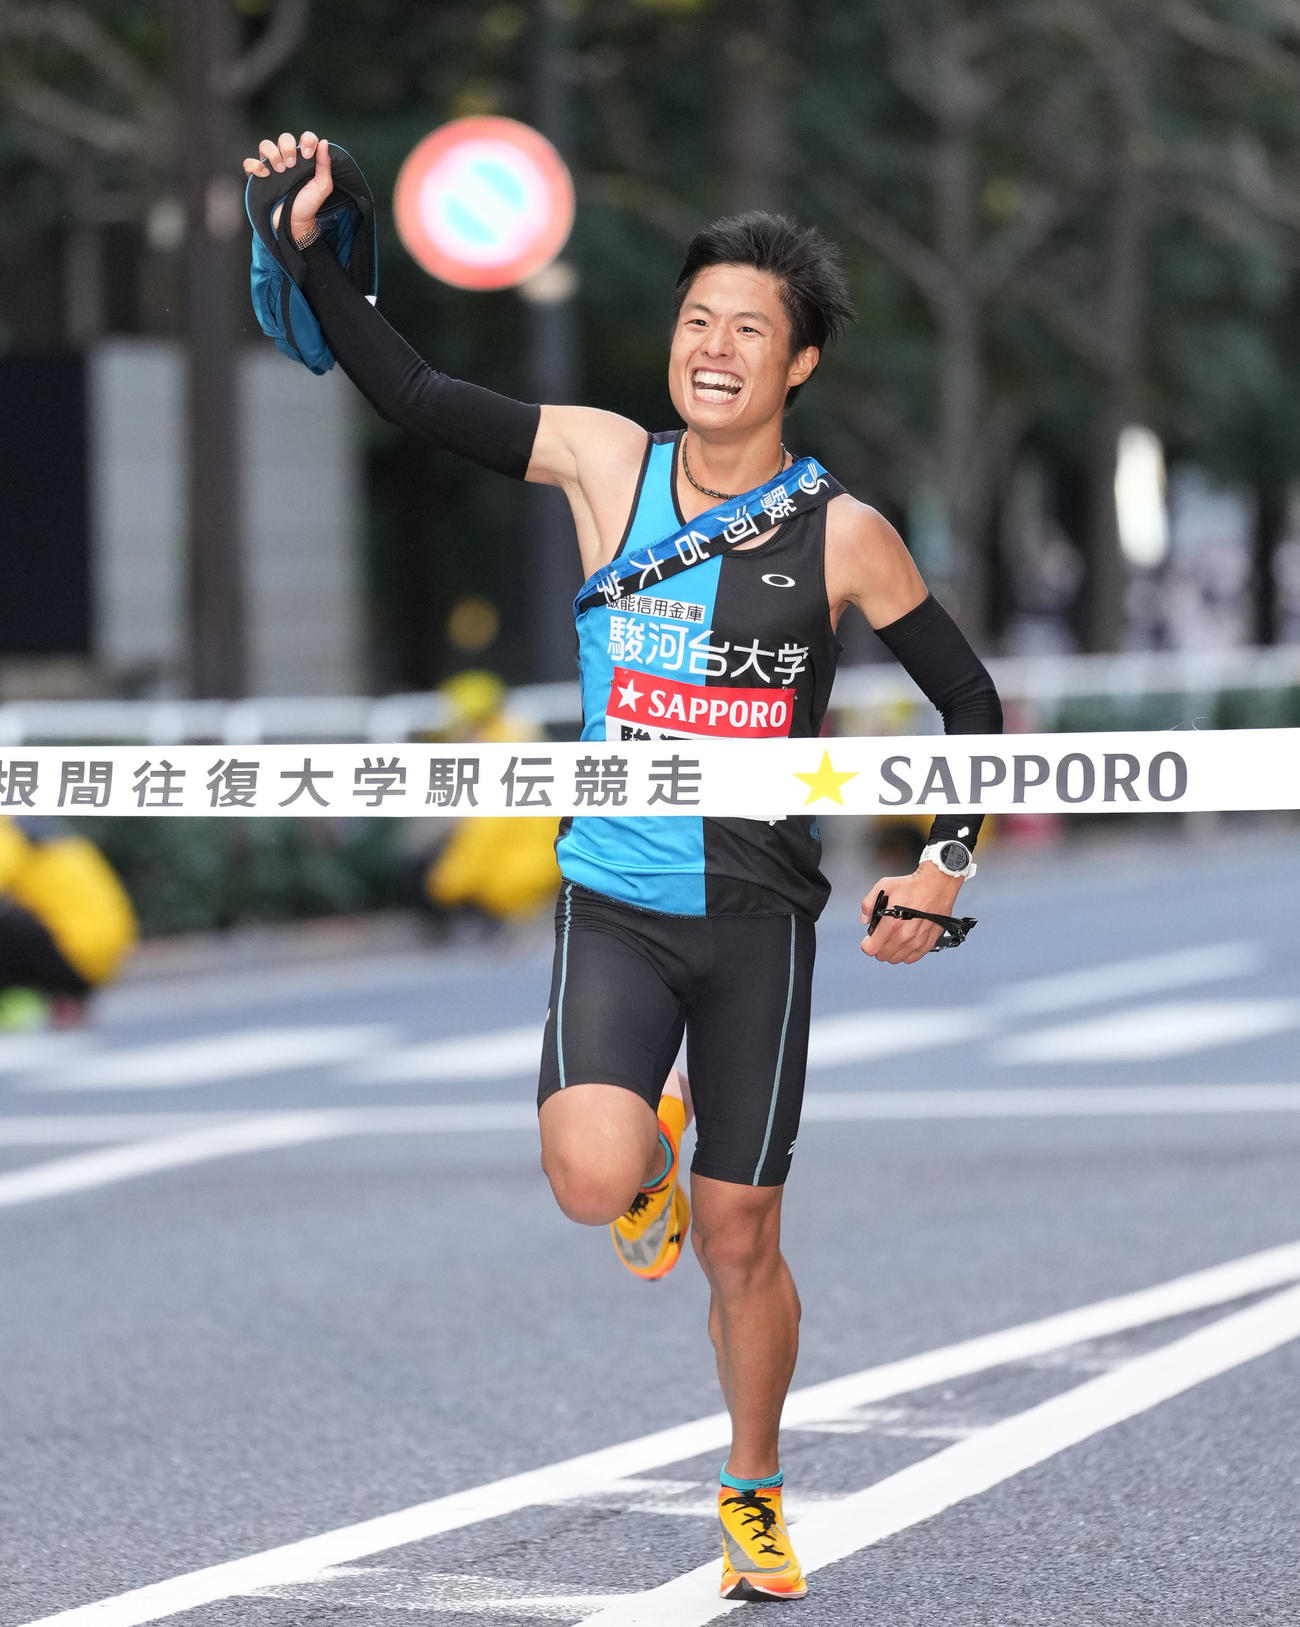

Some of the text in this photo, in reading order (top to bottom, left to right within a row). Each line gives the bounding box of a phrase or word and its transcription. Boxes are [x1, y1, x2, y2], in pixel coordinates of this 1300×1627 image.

[596, 484, 797, 603] 駿河台大学
[607, 615, 810, 685] 駿河台大学
[648, 690, 787, 728] SAPPORO
[0, 755, 703, 808] 根間往復大学駅伝競走
[878, 751, 1188, 806] SAPPORO
